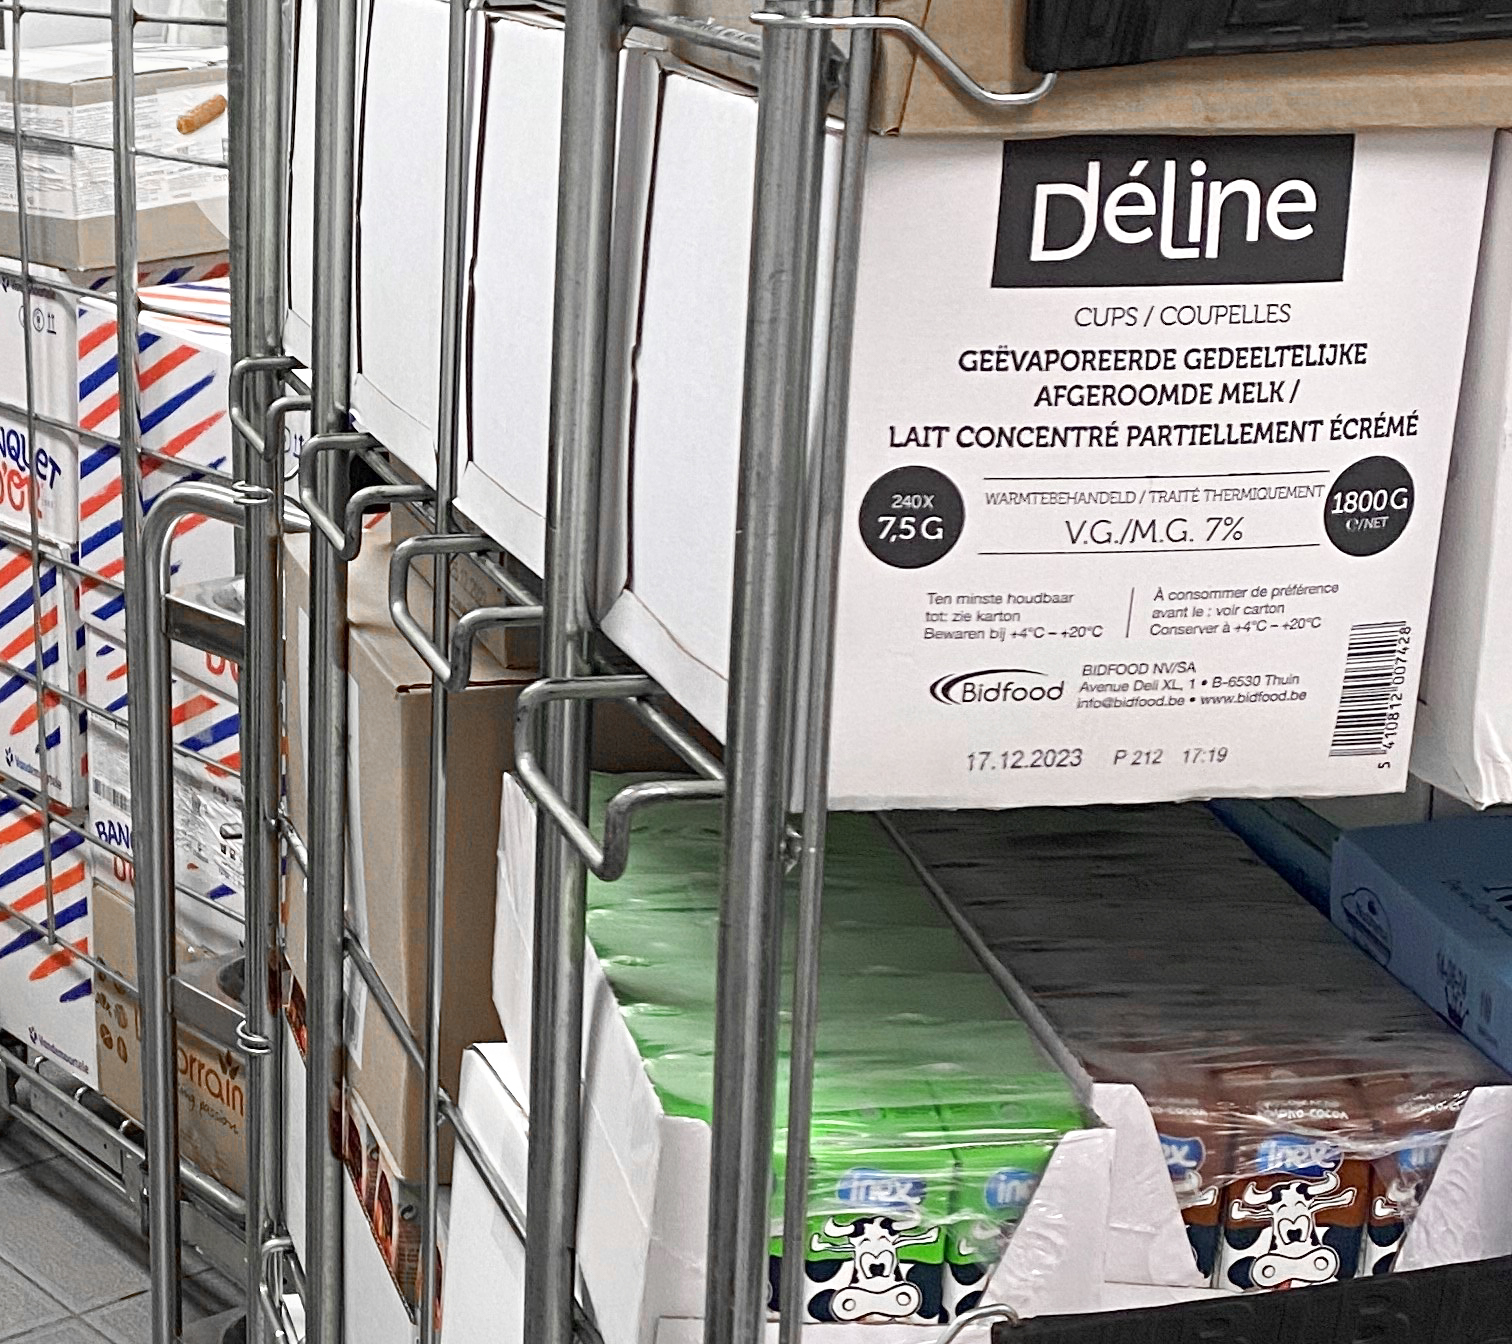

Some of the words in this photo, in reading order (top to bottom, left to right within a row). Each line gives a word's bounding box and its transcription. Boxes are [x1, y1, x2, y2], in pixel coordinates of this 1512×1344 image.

[1029, 158, 1318, 263] Déline
[1075, 306, 1138, 327] CUPS
[1160, 303, 1292, 326] COUPELLES
[958, 345, 1177, 372] GEËVAPOREERDE
[1184, 342, 1368, 370] GEDEELTELIJKE
[1034, 383, 1213, 407] AFGEROOMDE
[1218, 380, 1286, 405] MELK
[889, 425, 950, 448] LAIT
[956, 420, 1119, 448] CONCENTRÉ
[1126, 419, 1324, 447] PARTIELLEMENT
[1330, 409, 1419, 440] ÉCRÉMÉ
[891, 494, 935, 509] 240X
[985, 490, 1137, 506] WARMTEBEHANDELD
[1148, 487, 1199, 504] TRAITÉ
[1204, 484, 1326, 503] THERMIQUEMENT
[1065, 518, 1195, 545] V.G./M.G.
[1205, 516, 1245, 542] 7%
[928, 592, 952, 604] Ten
[956, 592, 1003, 605] minste
[1007, 592, 1075, 604] houdbaar
[1168, 588, 1248, 601] consommer
[1251, 585, 1268, 598] de
[951, 611, 972, 622] zie
[976, 611, 1021, 622] karton
[1152, 607, 1189, 619] avant
[1216, 605, 1239, 616] voir
[1243, 603, 1285, 616] carton
[924, 627, 985, 640] Bewaren
[989, 627, 1006, 642] bij
[1150, 623, 1221, 636] Conserver
[1082, 663, 1149, 677] BIDFOOD
[1153, 661, 1196, 674] NV/SA
[962, 680, 1065, 703] Bidfood
[1079, 680, 1129, 693] Avenue
[1211, 675, 1261, 688] B-6530
[1265, 674, 1300, 686] Thuin
[1200, 690, 1307, 704] www.bidfood.be
[968, 748, 1083, 771] 17.12.2023
[1114, 749, 1128, 765] P
[1131, 749, 1164, 765] 212
[1183, 747, 1229, 764] 17:19
